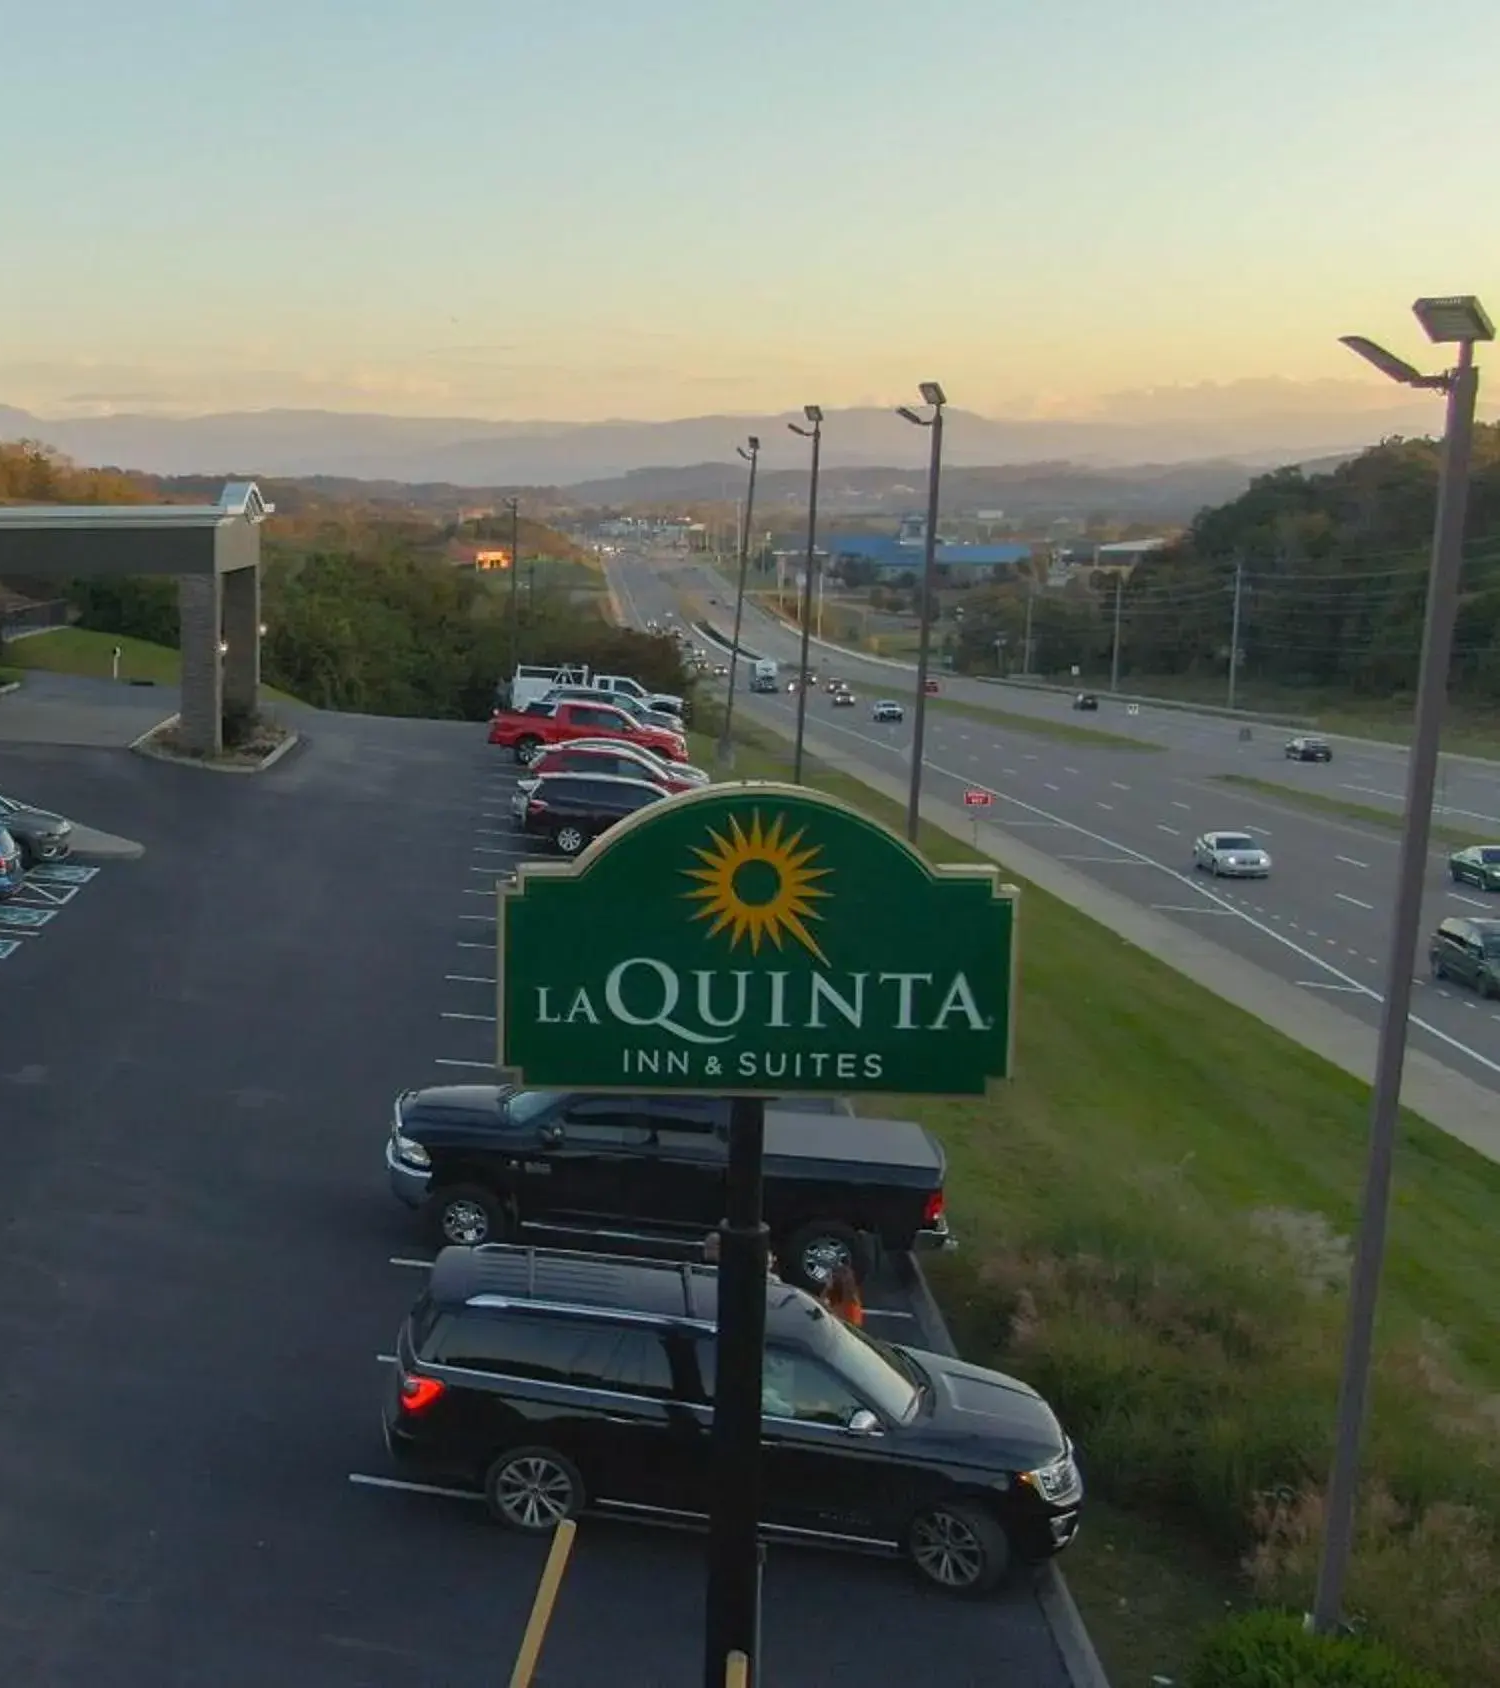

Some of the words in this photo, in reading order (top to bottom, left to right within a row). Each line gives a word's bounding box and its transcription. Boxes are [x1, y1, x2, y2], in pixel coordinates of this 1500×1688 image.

[534, 986, 601, 1025] LA
[605, 956, 992, 1044] QUINTA
[623, 1049, 690, 1075] INN
[704, 1055, 723, 1075] &
[738, 1051, 884, 1078] SUITES
